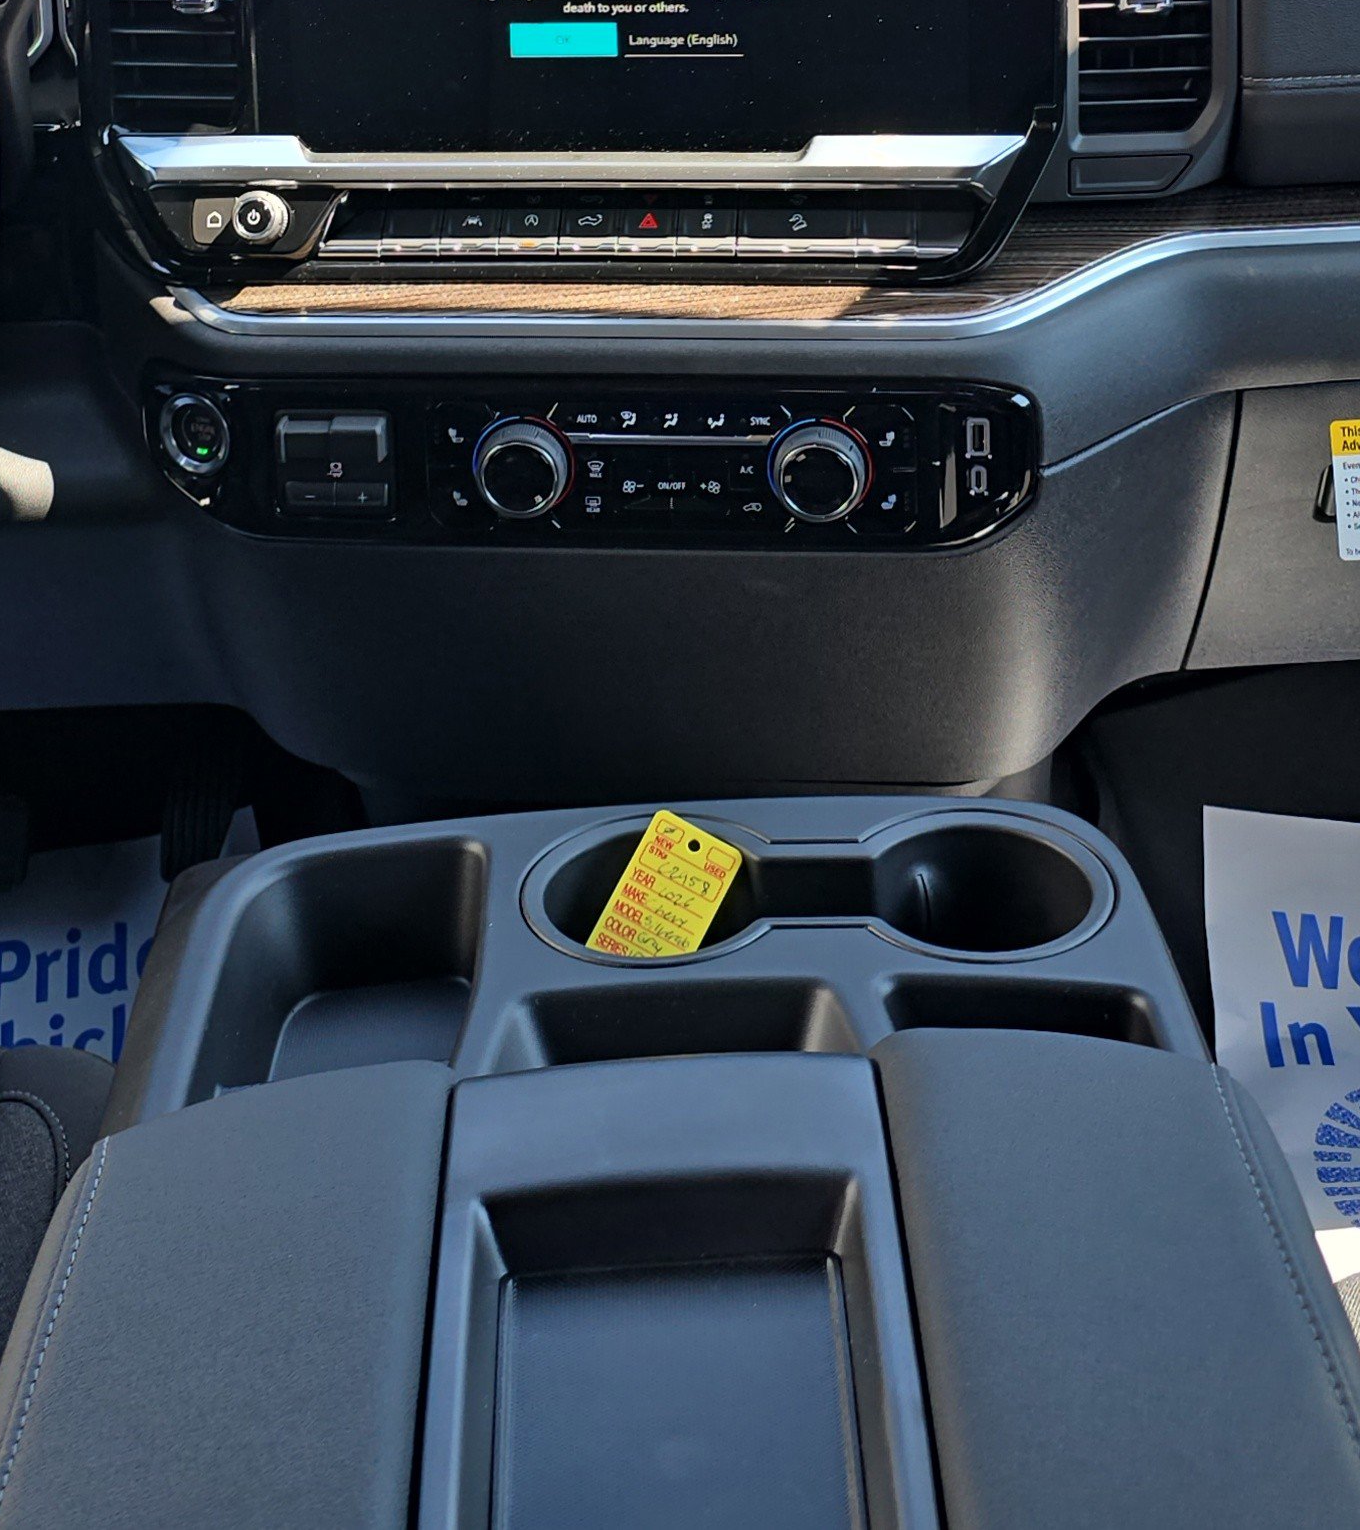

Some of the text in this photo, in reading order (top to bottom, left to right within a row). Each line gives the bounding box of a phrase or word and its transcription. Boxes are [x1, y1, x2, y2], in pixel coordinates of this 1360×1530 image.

[563, 1, 689, 16] death to you or others.
[629, 34, 685, 47] Language
[687, 33, 738, 47] (English)
[576, 414, 597, 423] AUTO
[750, 416, 771, 426] SYNC
[1343, 461, 1360, 470] Even
[657, 481, 686, 491] ON/OFF
[654, 835, 674, 850] NEW
[631, 867, 656, 888] YEAR
[705, 862, 726, 878] USED
[623, 883, 649, 905] MAKE
[614, 900, 643, 925] MODEL
[605, 916, 637, 941] COLOR
[596, 933, 629, 956] SERIES
[1259, 1001, 1336, 1068] In
